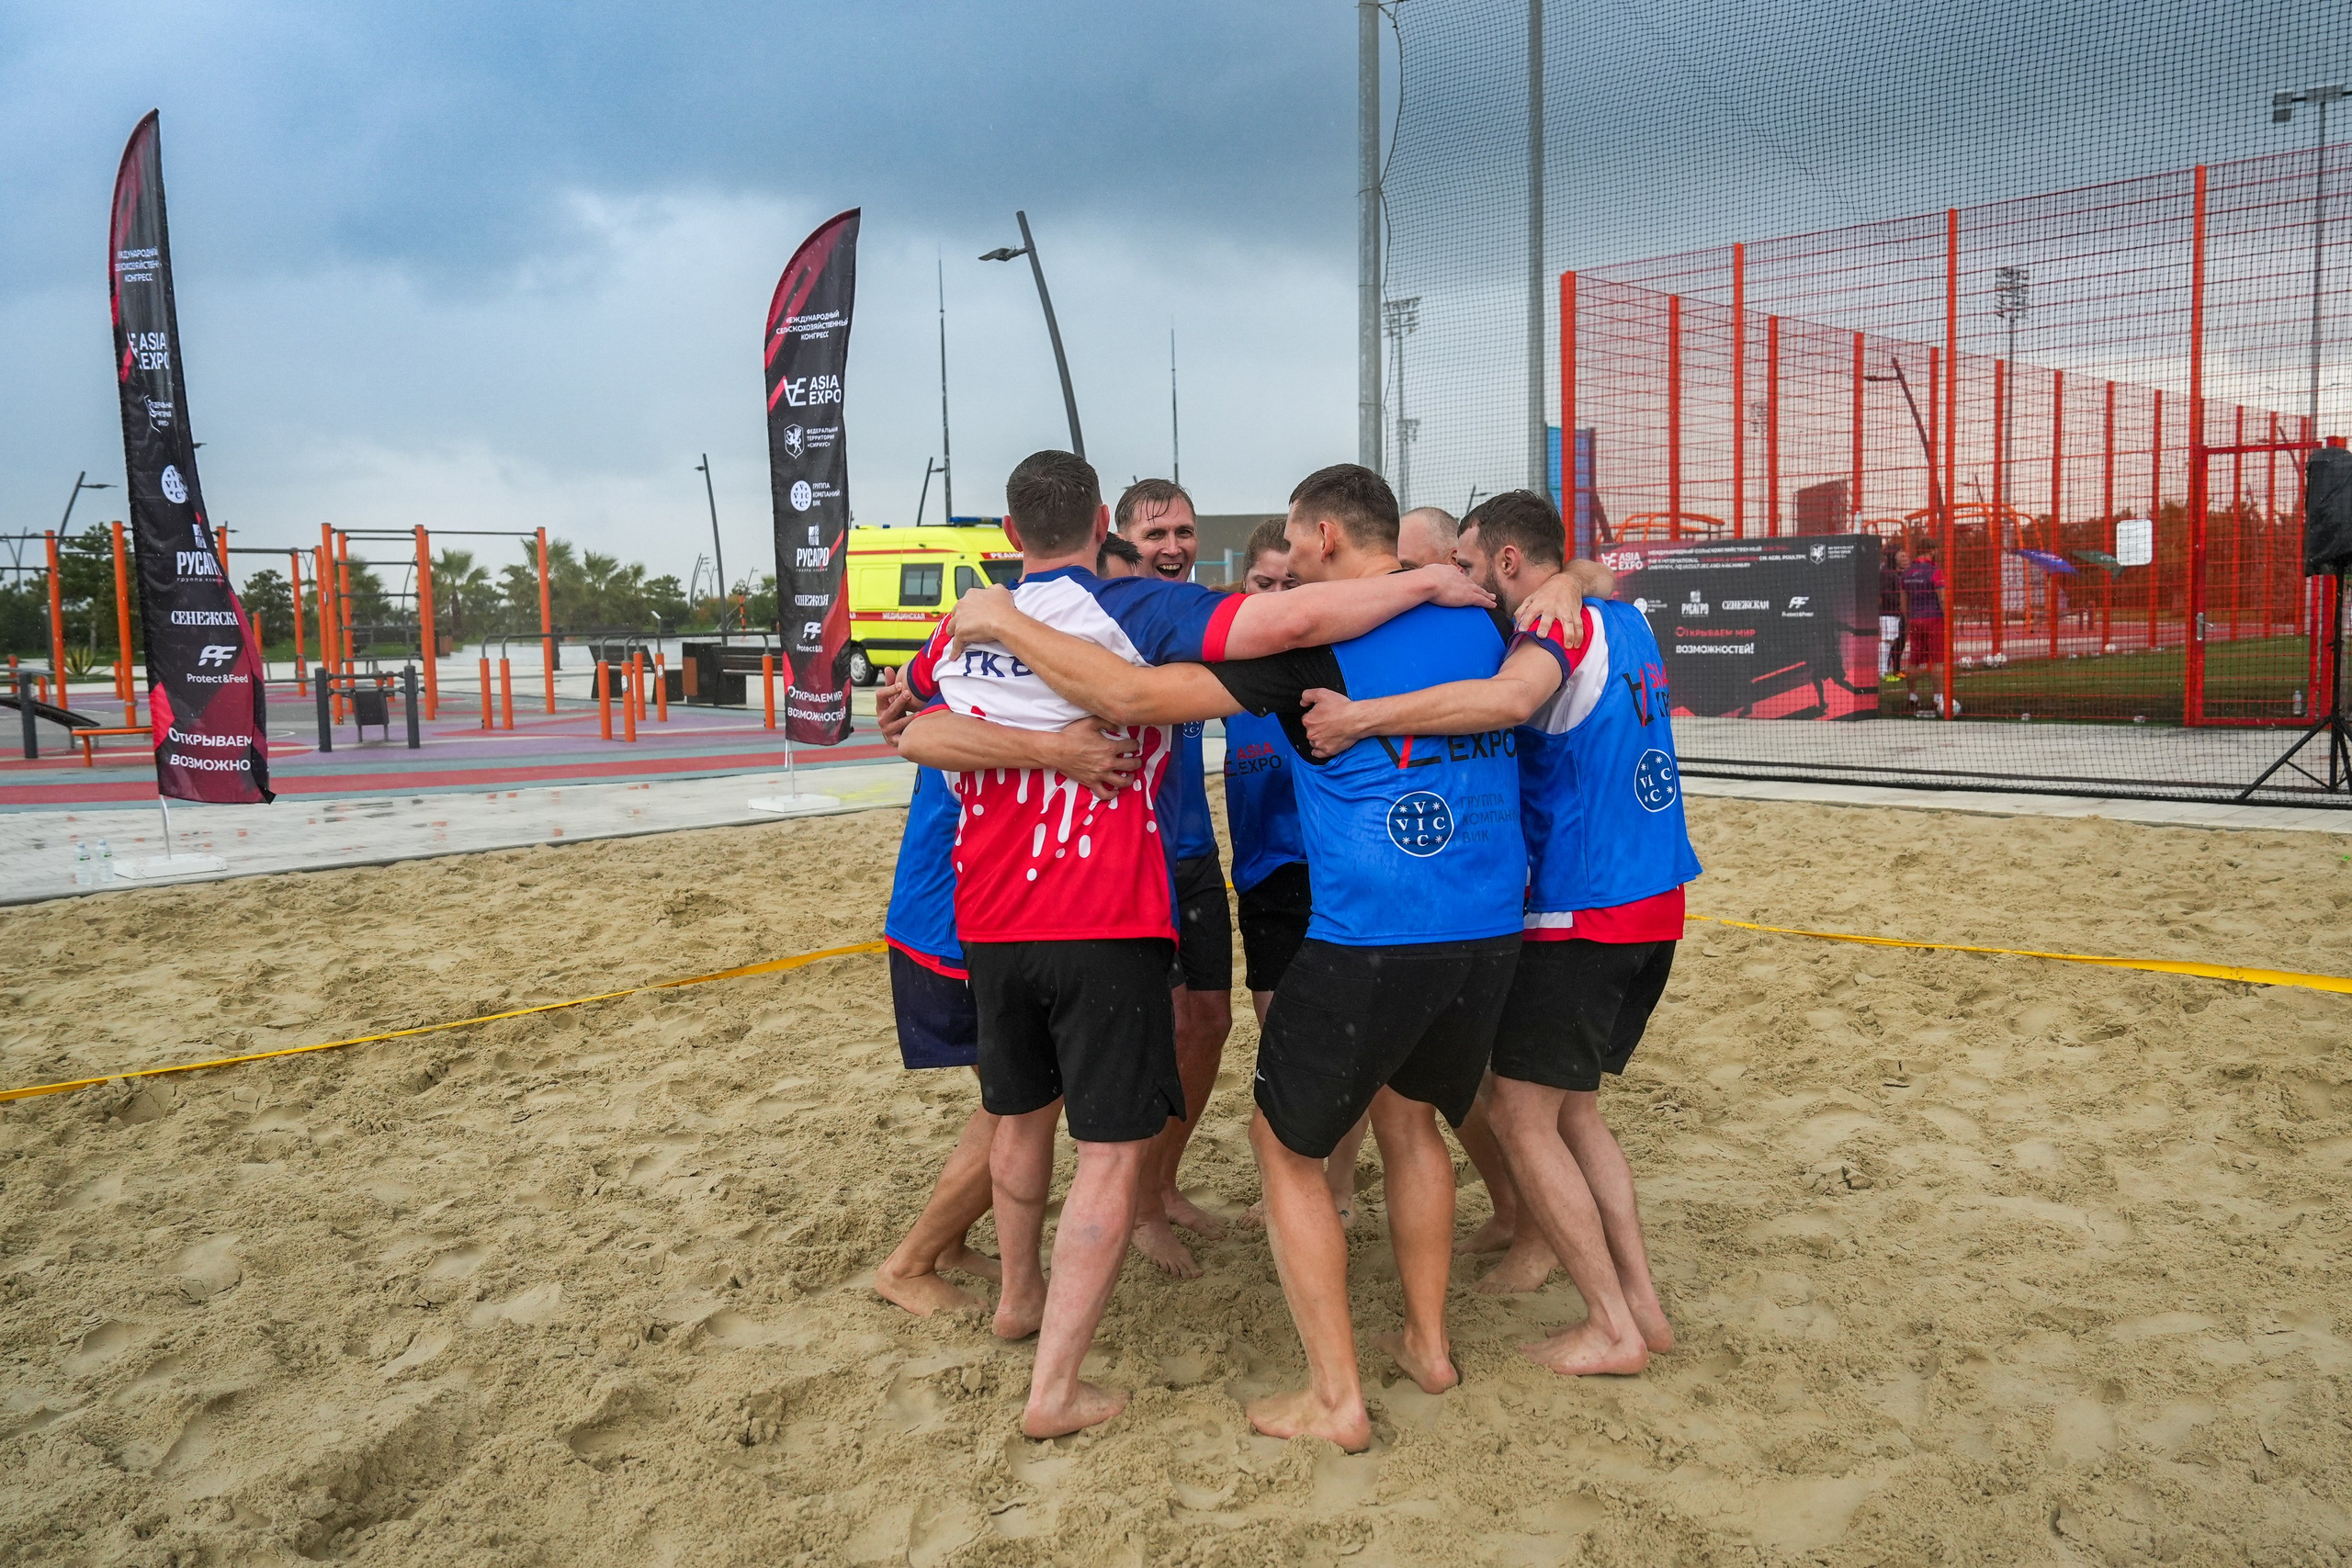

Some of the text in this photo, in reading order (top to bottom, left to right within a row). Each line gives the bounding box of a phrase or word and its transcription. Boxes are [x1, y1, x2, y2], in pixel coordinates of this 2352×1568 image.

[140, 332, 167, 350] ASIA
[801, 331, 830, 340] КОНГРЕСС
[809, 375, 840, 390] ASIA
[808, 389, 842, 405] EXPO
[1619, 551, 1641, 561] ASIA
[1619, 560, 1643, 570] EXPO
[1681, 603, 1709, 615] РУСАГРО
[1676, 642, 1755, 654] ВОЗМОЖНОСТЕЙ!
[187, 672, 249, 683] Protect&Feed
[1237, 742, 1275, 761] ASIA
[1447, 728, 1517, 762] EXPO
[170, 754, 252, 772] ВОЗМОЖНО
[1238, 755, 1283, 775] EXPO
[1459, 793, 1505, 808] ГРУППА
[1462, 829, 1489, 843] ВИК
